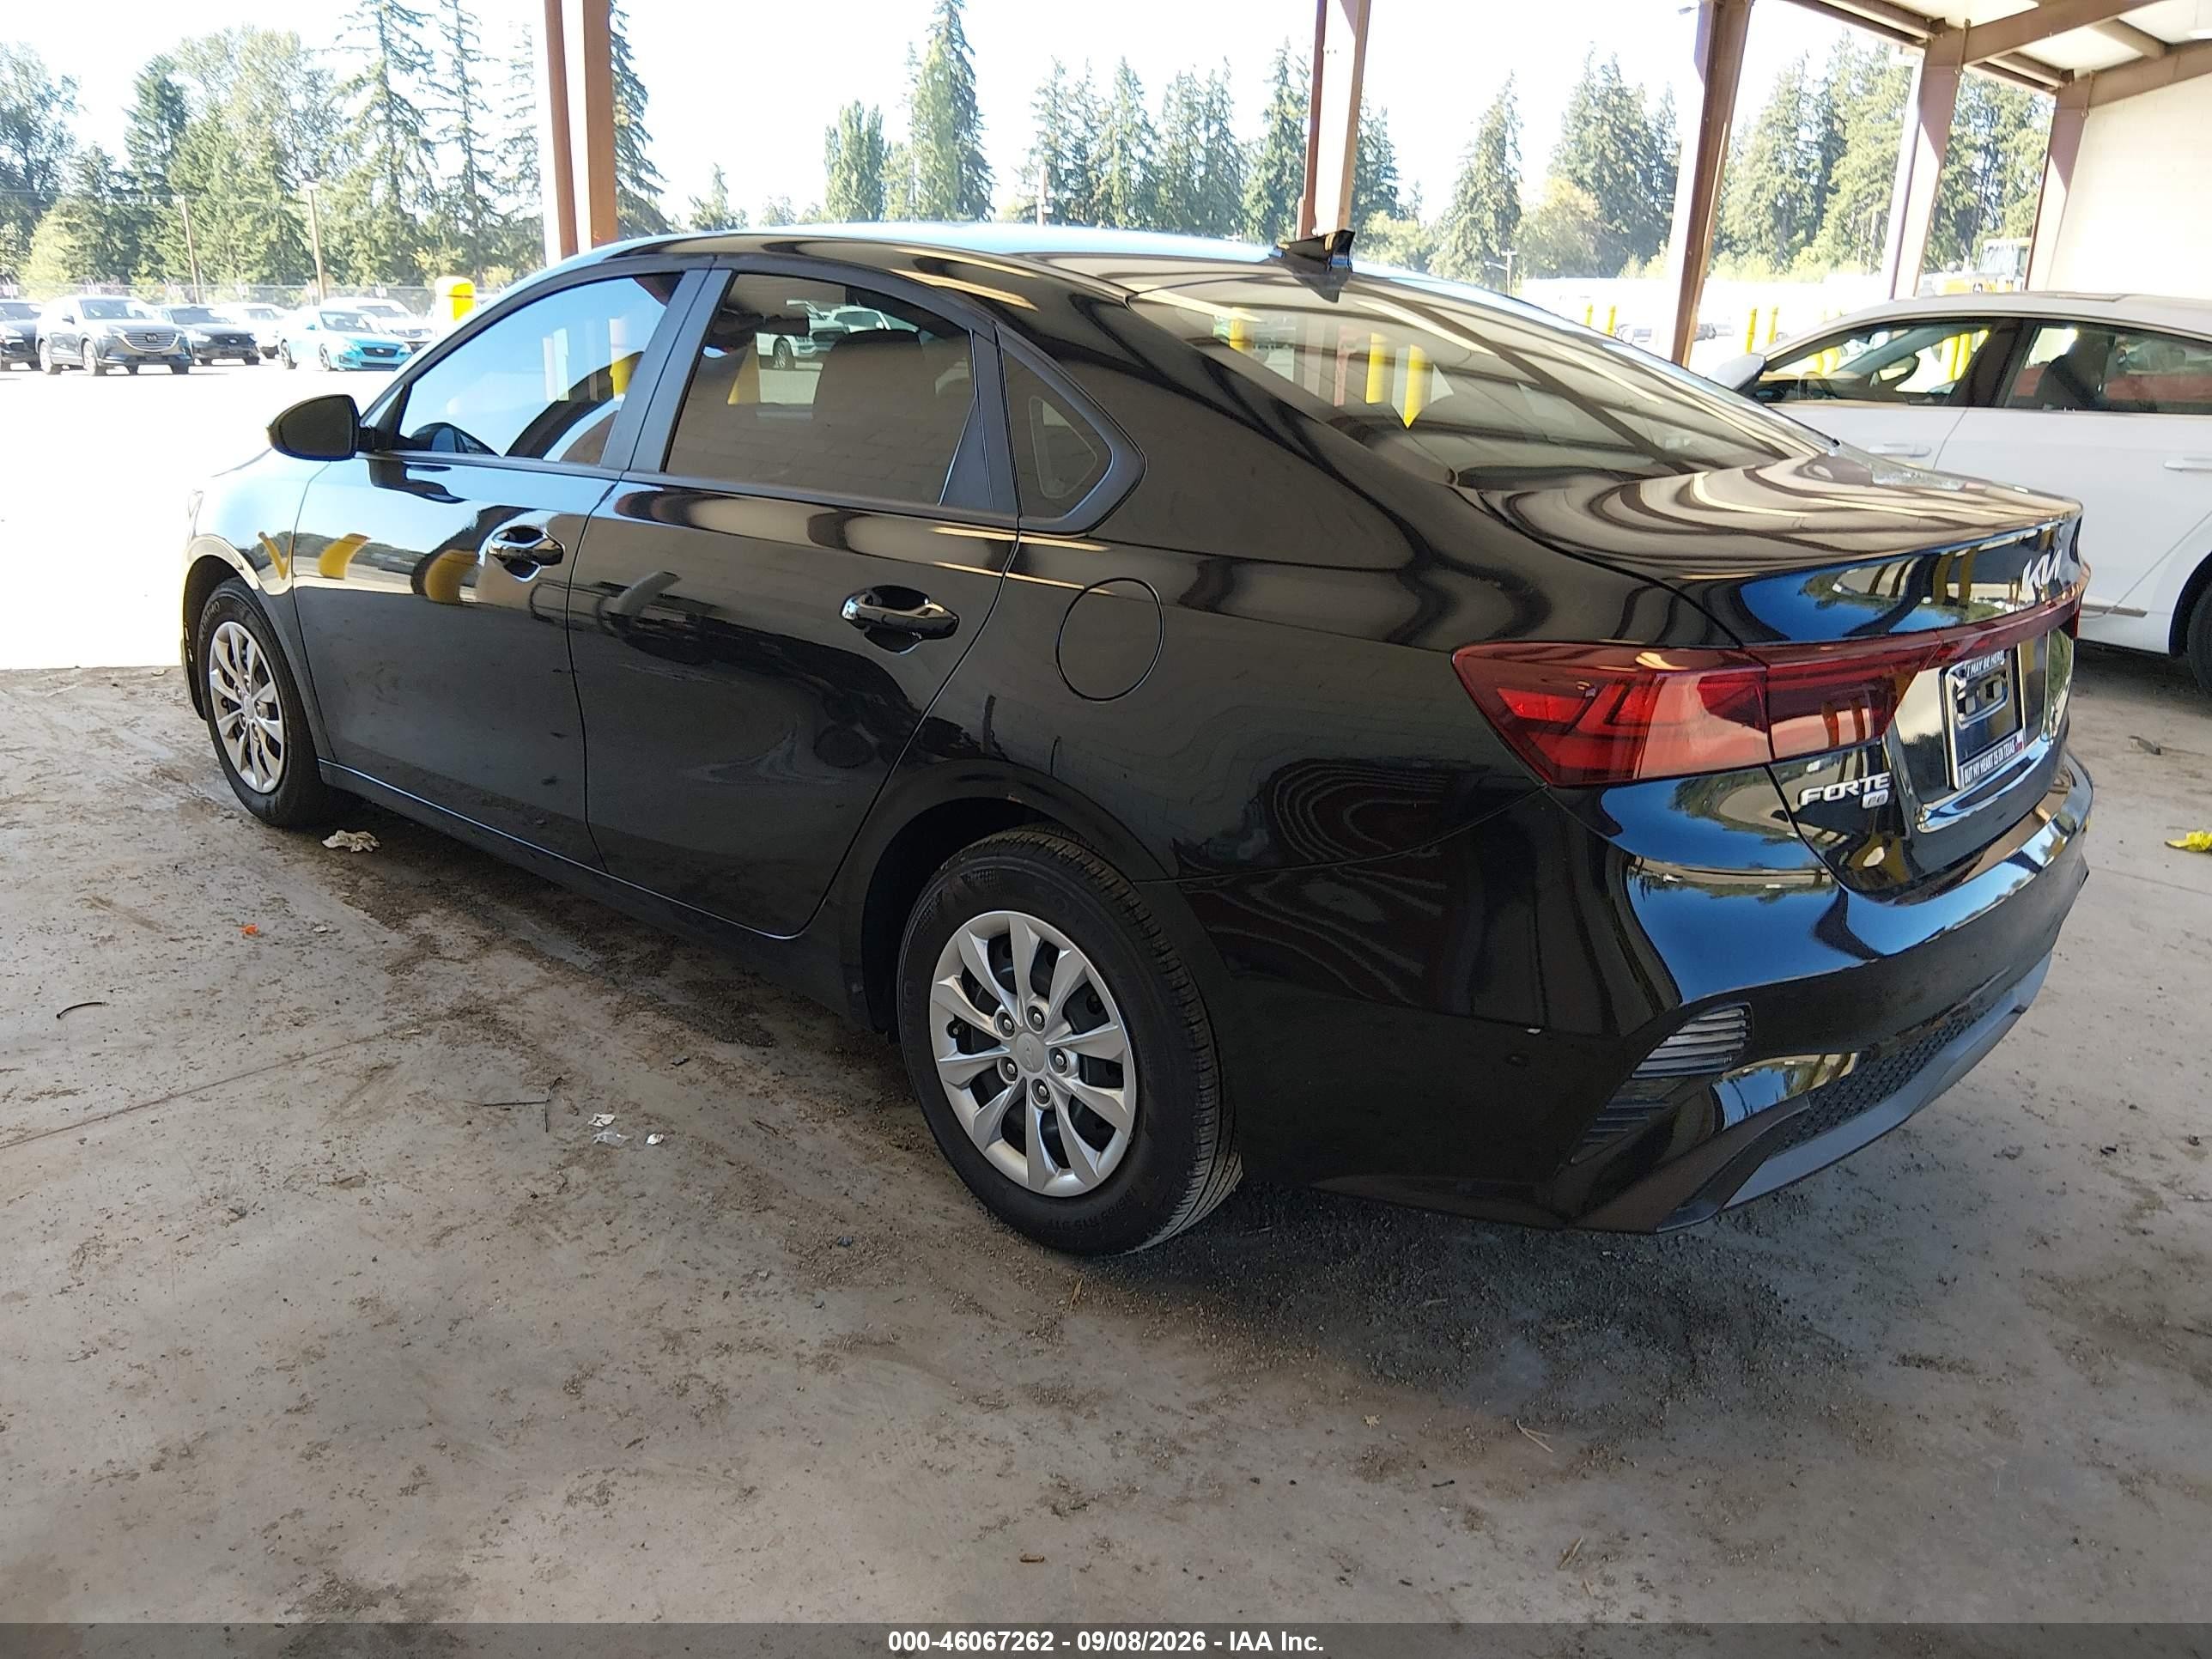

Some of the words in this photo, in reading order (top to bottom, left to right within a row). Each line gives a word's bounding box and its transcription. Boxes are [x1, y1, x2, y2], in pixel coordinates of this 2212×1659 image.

[1971, 659, 1983, 675] MAY
[1964, 765, 1973, 784] BUT
[1973, 761, 1980, 777] MY
[1980, 753, 1993, 774] HEART
[1993, 750, 1998, 766] IS
[1998, 745, 2003, 763] IN
[2003, 738, 2015, 758] TEXAS
[1801, 772, 1891, 806] FORTE
